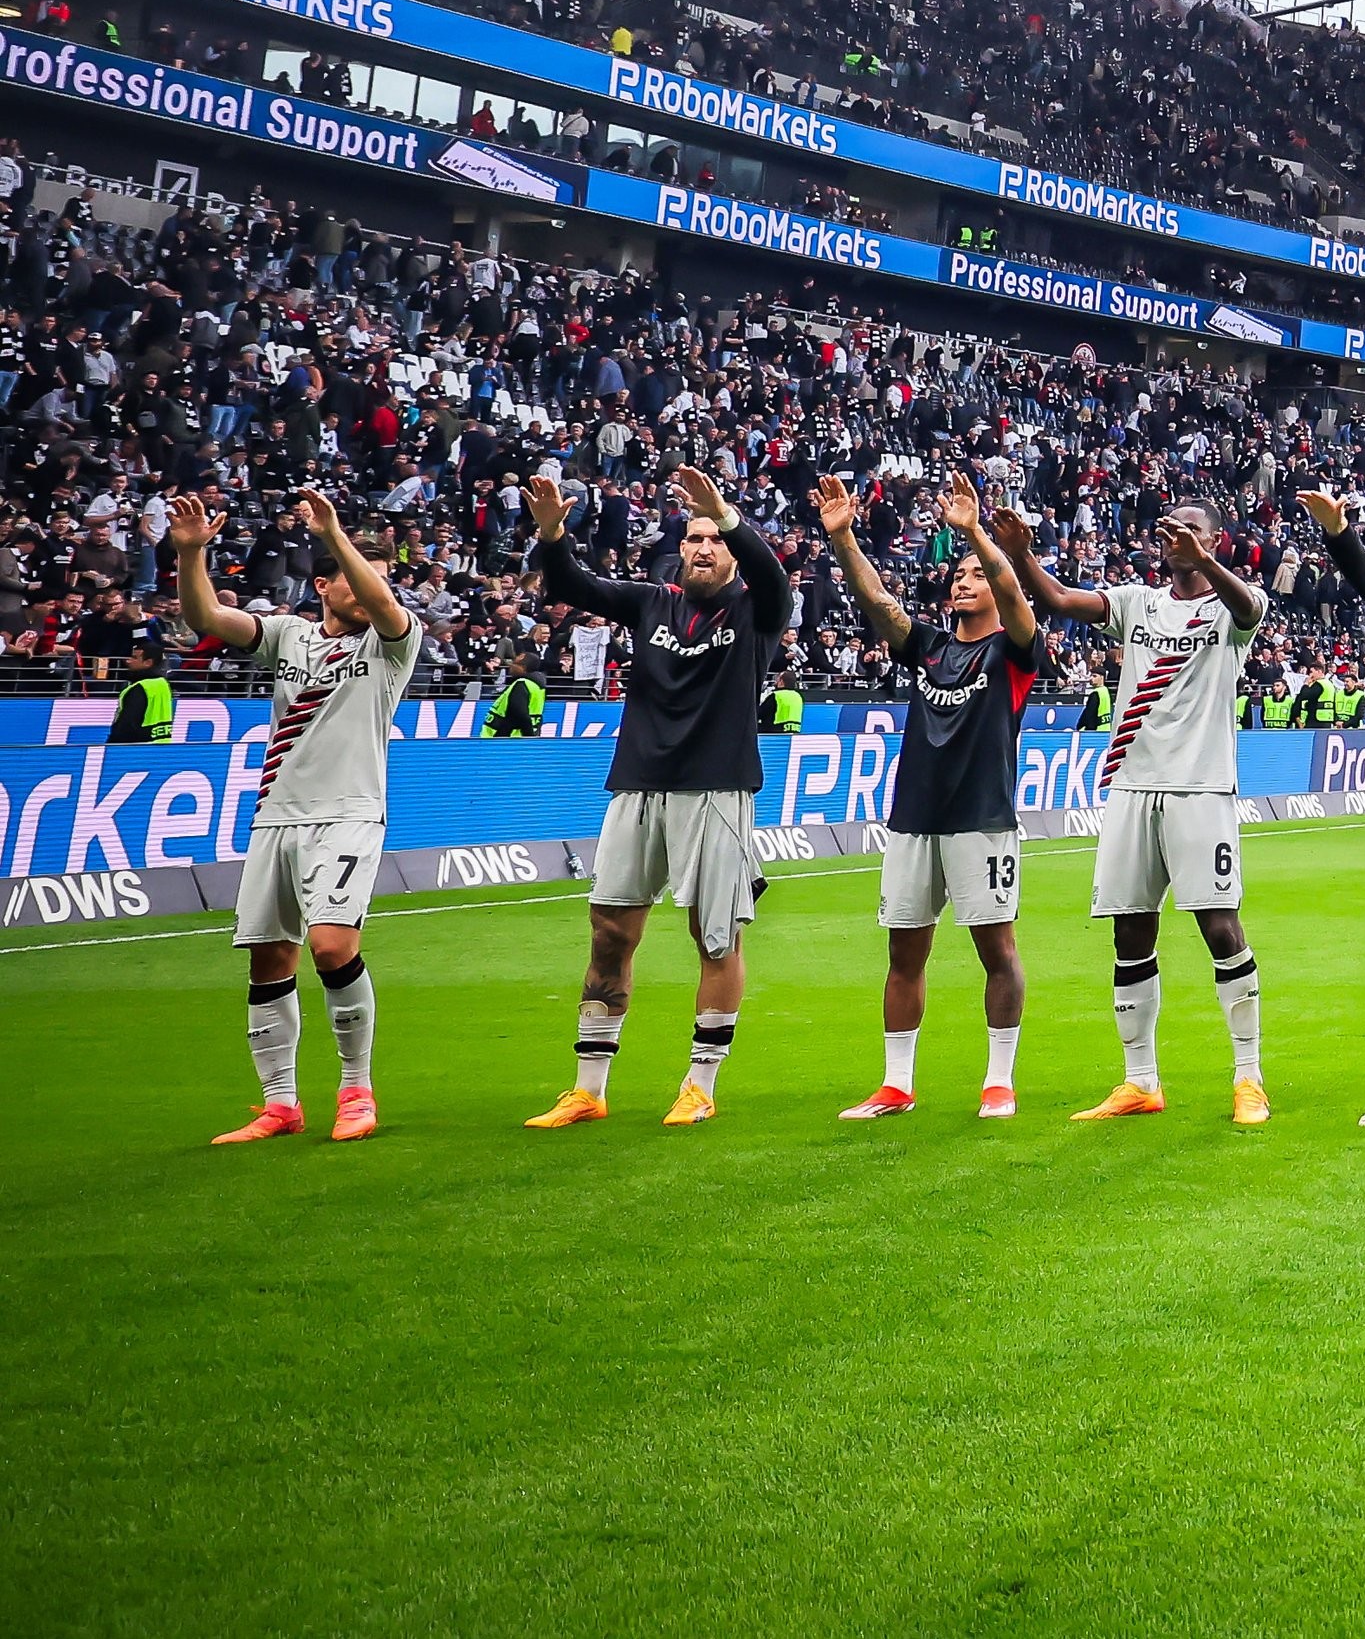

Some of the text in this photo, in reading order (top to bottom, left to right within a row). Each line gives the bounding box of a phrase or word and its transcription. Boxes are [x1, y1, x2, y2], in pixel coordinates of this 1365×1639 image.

[267, 98, 419, 171] Support
[641, 63, 838, 158] RoboMarkets
[690, 189, 882, 271] RoboMarkets
[1025, 170, 1180, 239] RoboMarkets
[951, 251, 1101, 312] Professional
[1109, 284, 1199, 330] Support
[335, 854, 359, 890] 7
[986, 854, 1016, 890] 13
[1214, 842, 1232, 876] 6
